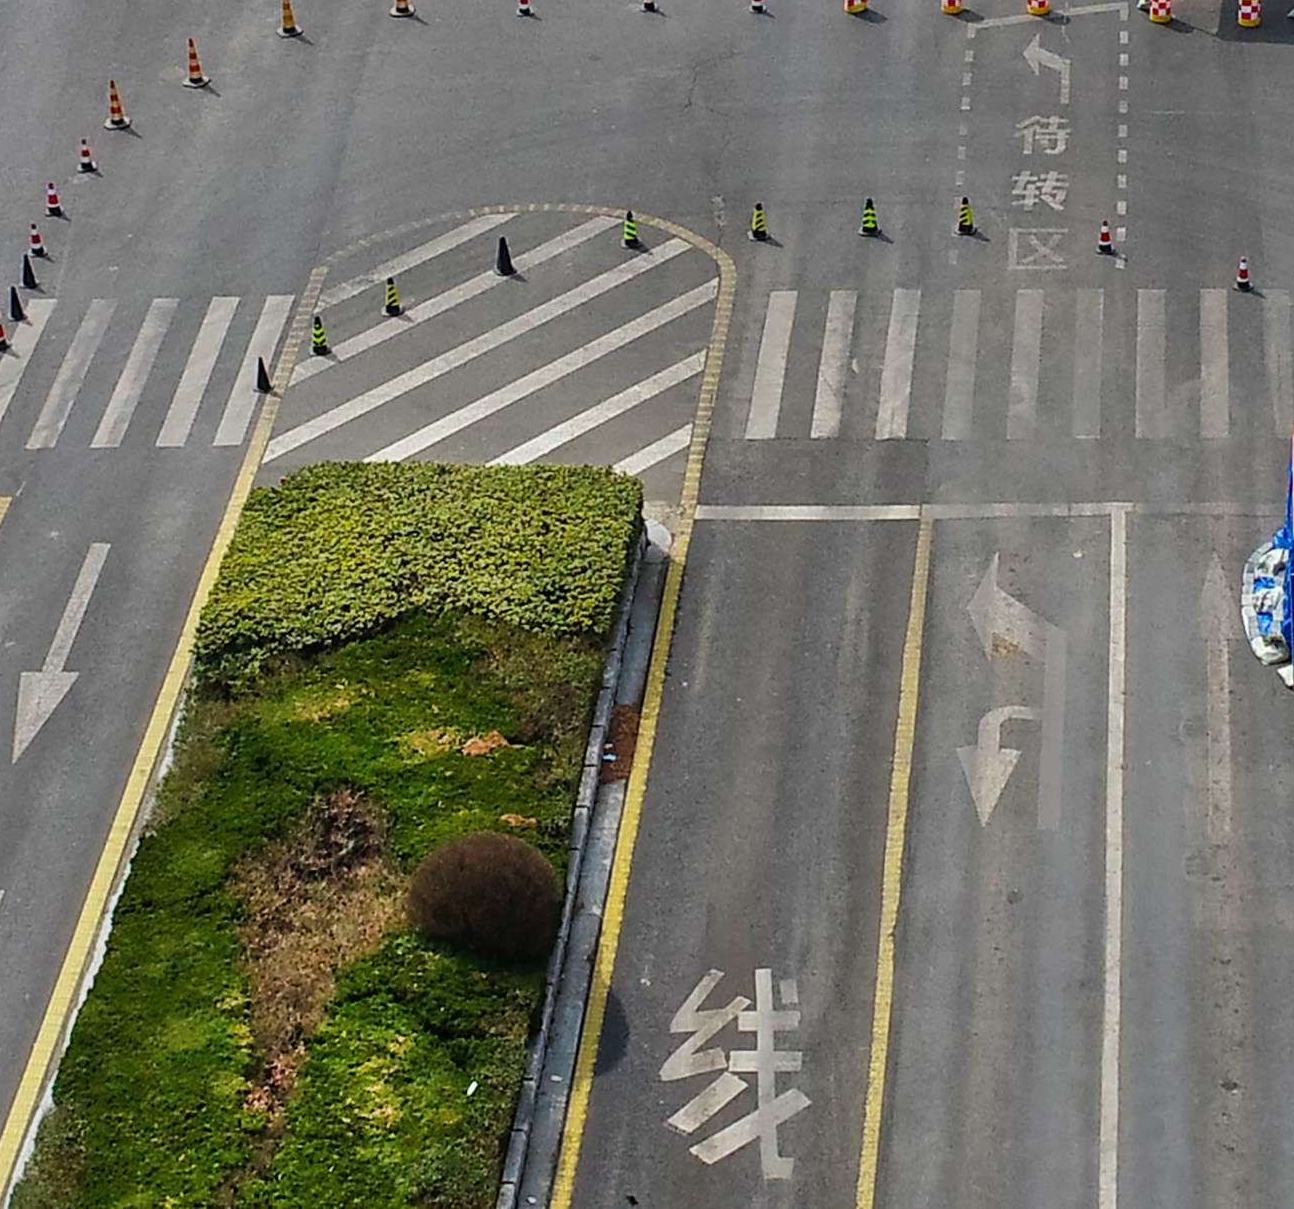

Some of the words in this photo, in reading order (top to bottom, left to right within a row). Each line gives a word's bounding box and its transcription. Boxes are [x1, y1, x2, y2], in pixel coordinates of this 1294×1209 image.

[1008, 115, 1070, 270] 待转区
[659, 968, 812, 1179] 线
